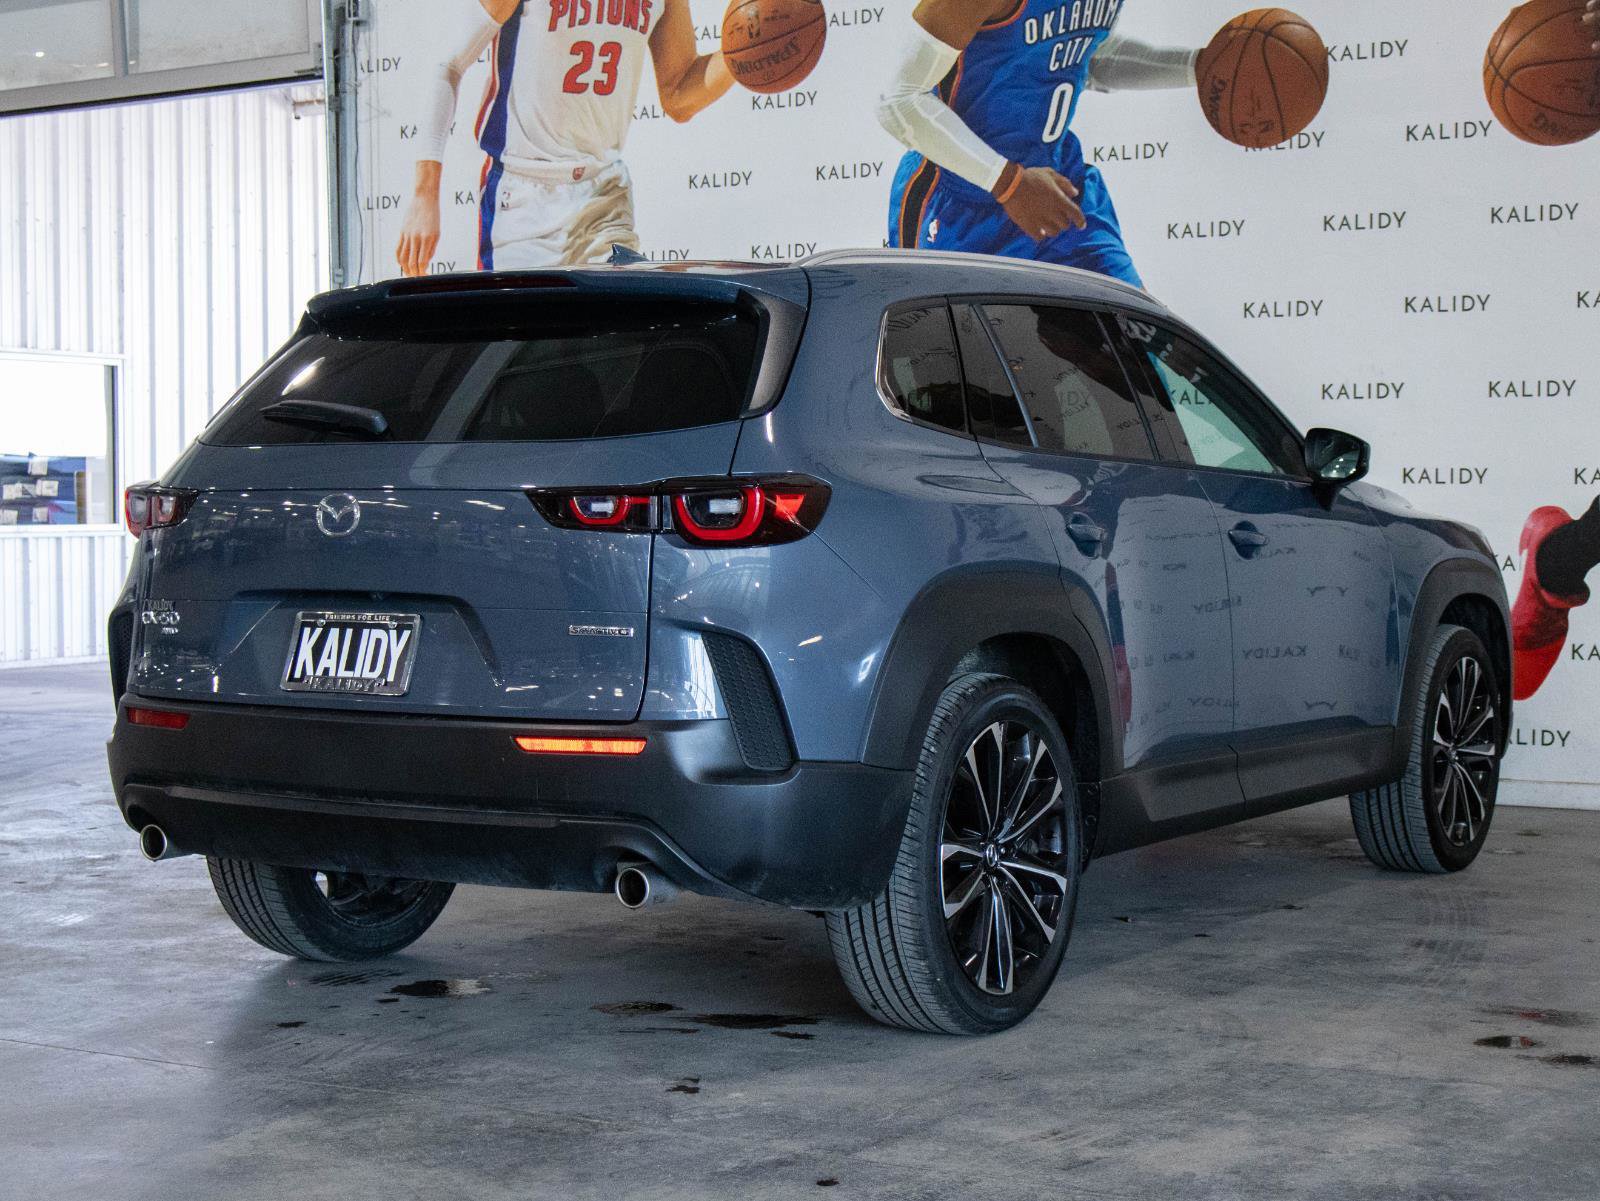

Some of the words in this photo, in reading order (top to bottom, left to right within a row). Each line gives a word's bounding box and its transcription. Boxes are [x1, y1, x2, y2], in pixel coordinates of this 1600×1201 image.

[829, 7, 885, 27] ALIDY
[1025, 0, 1118, 44] OKLAHOM
[1049, 36, 1094, 72] CITY
[1328, 39, 1408, 65] KALIDY
[360, 56, 401, 73] LIDY
[562, 40, 623, 96] 23
[752, 91, 818, 110] KALIDY
[1042, 82, 1074, 143] 0
[1406, 120, 1492, 141] KALIDY
[1093, 142, 1169, 162] KALIDY
[689, 171, 752, 189] KALIDY
[816, 162, 883, 181] KALIDY
[366, 194, 401, 210] LIDY
[1324, 212, 1406, 232] KALIDY
[1490, 203, 1579, 224] KALIDY
[1167, 220, 1246, 240] KALIDY
[752, 243, 817, 259] KALIDY
[1243, 300, 1323, 318] KALIDY
[1405, 294, 1491, 313] KALIDY
[1321, 382, 1405, 400] KALIDY
[1488, 380, 1577, 398] KALIDY
[1402, 468, 1488, 485] KALIDY
[294, 626, 412, 682] KALIDY
[1508, 728, 1571, 747] LIDY
